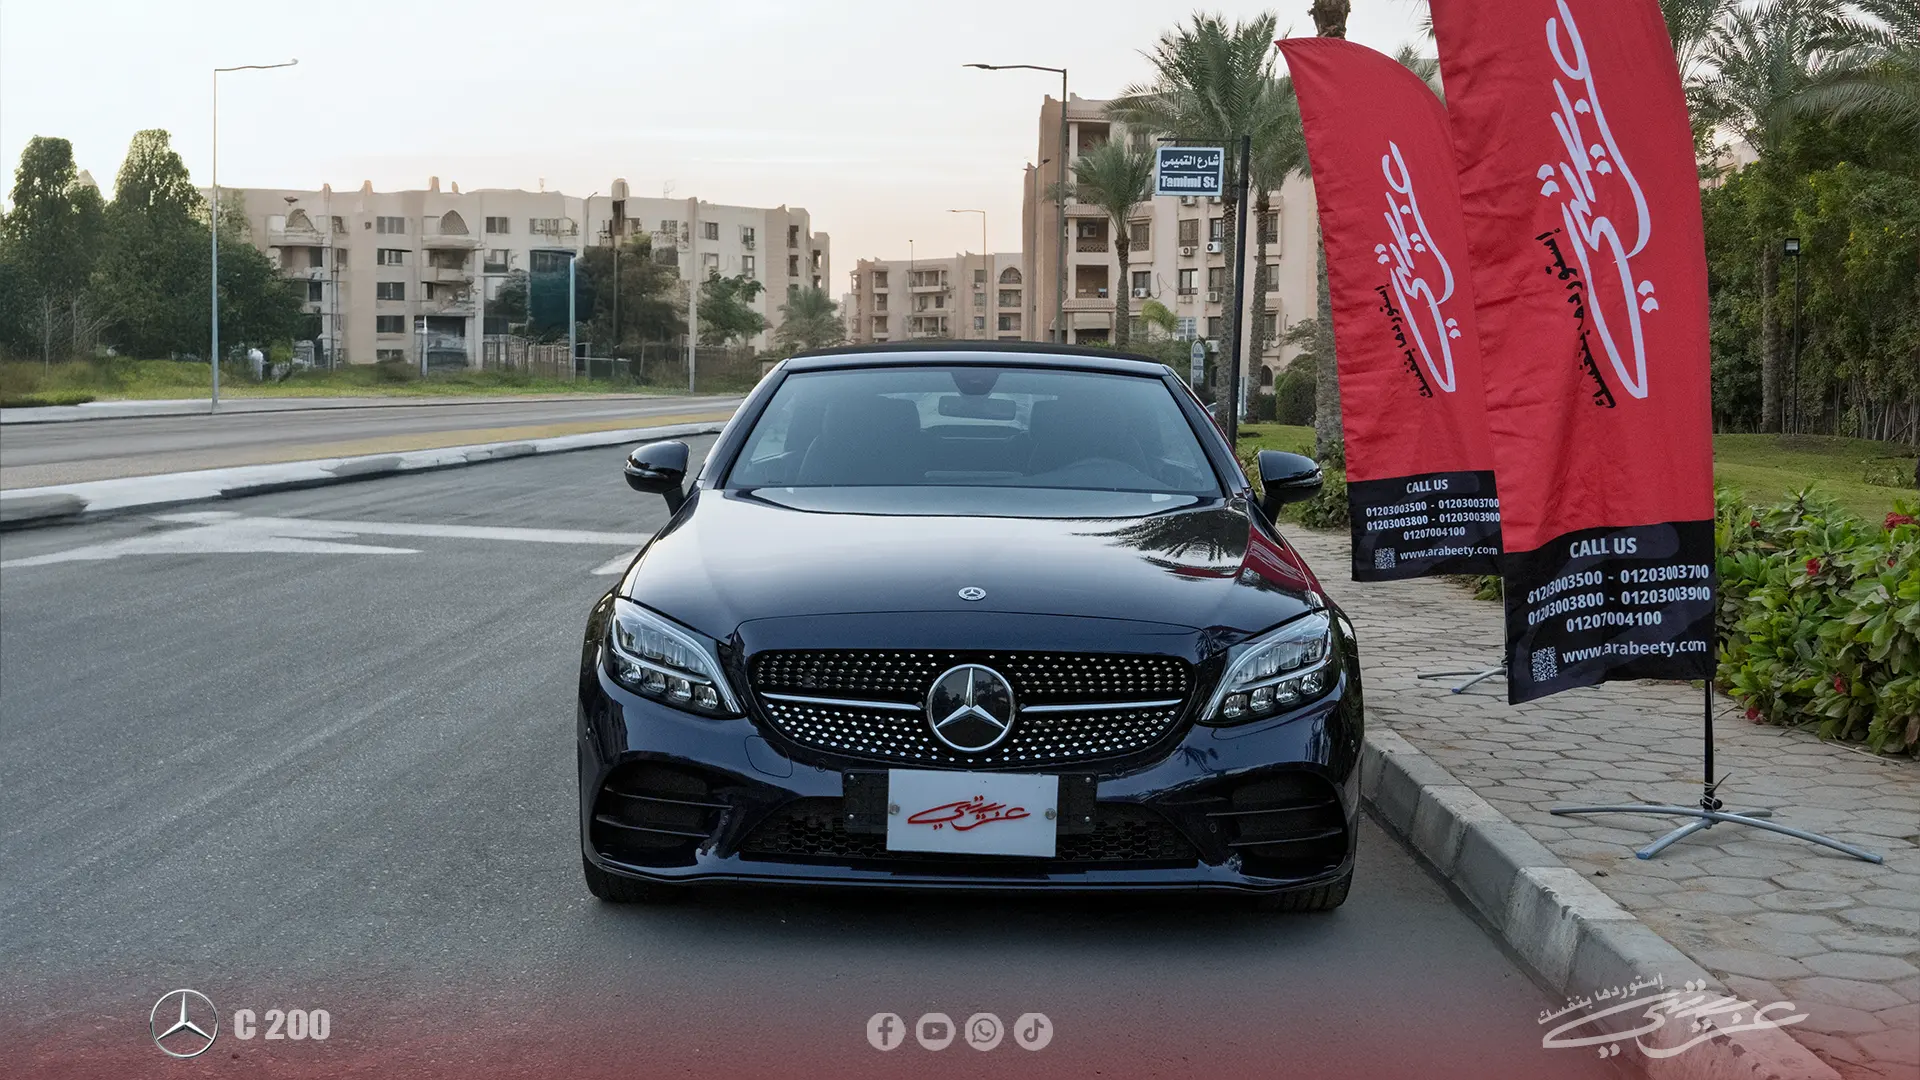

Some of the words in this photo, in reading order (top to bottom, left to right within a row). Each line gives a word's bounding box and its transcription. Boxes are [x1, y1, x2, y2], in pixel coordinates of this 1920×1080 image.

[1197, 154, 1219, 169] شارع
[1161, 176, 1202, 188] Tamimi
[1203, 176, 1218, 188] St.
[1406, 481, 1432, 494] CALL
[1433, 479, 1449, 491] US
[1366, 501, 1427, 518] 01203003500
[1438, 498, 1500, 510] 01203003700
[1366, 515, 1428, 531] 01203003800
[1439, 512, 1500, 524] 01203003900
[1403, 526, 1466, 541] 01207004100
[1400, 545, 1498, 560] www.arabeety.com
[1569, 538, 1610, 559] CALL
[1613, 537, 1638, 555] US
[1620, 564, 1709, 584] 01203003700
[1528, 592, 1604, 626] 01203003800
[1621, 586, 1711, 605] 01203003900
[1566, 611, 1662, 633] 01207004100
[1562, 640, 1706, 664] www.arabeety.com
